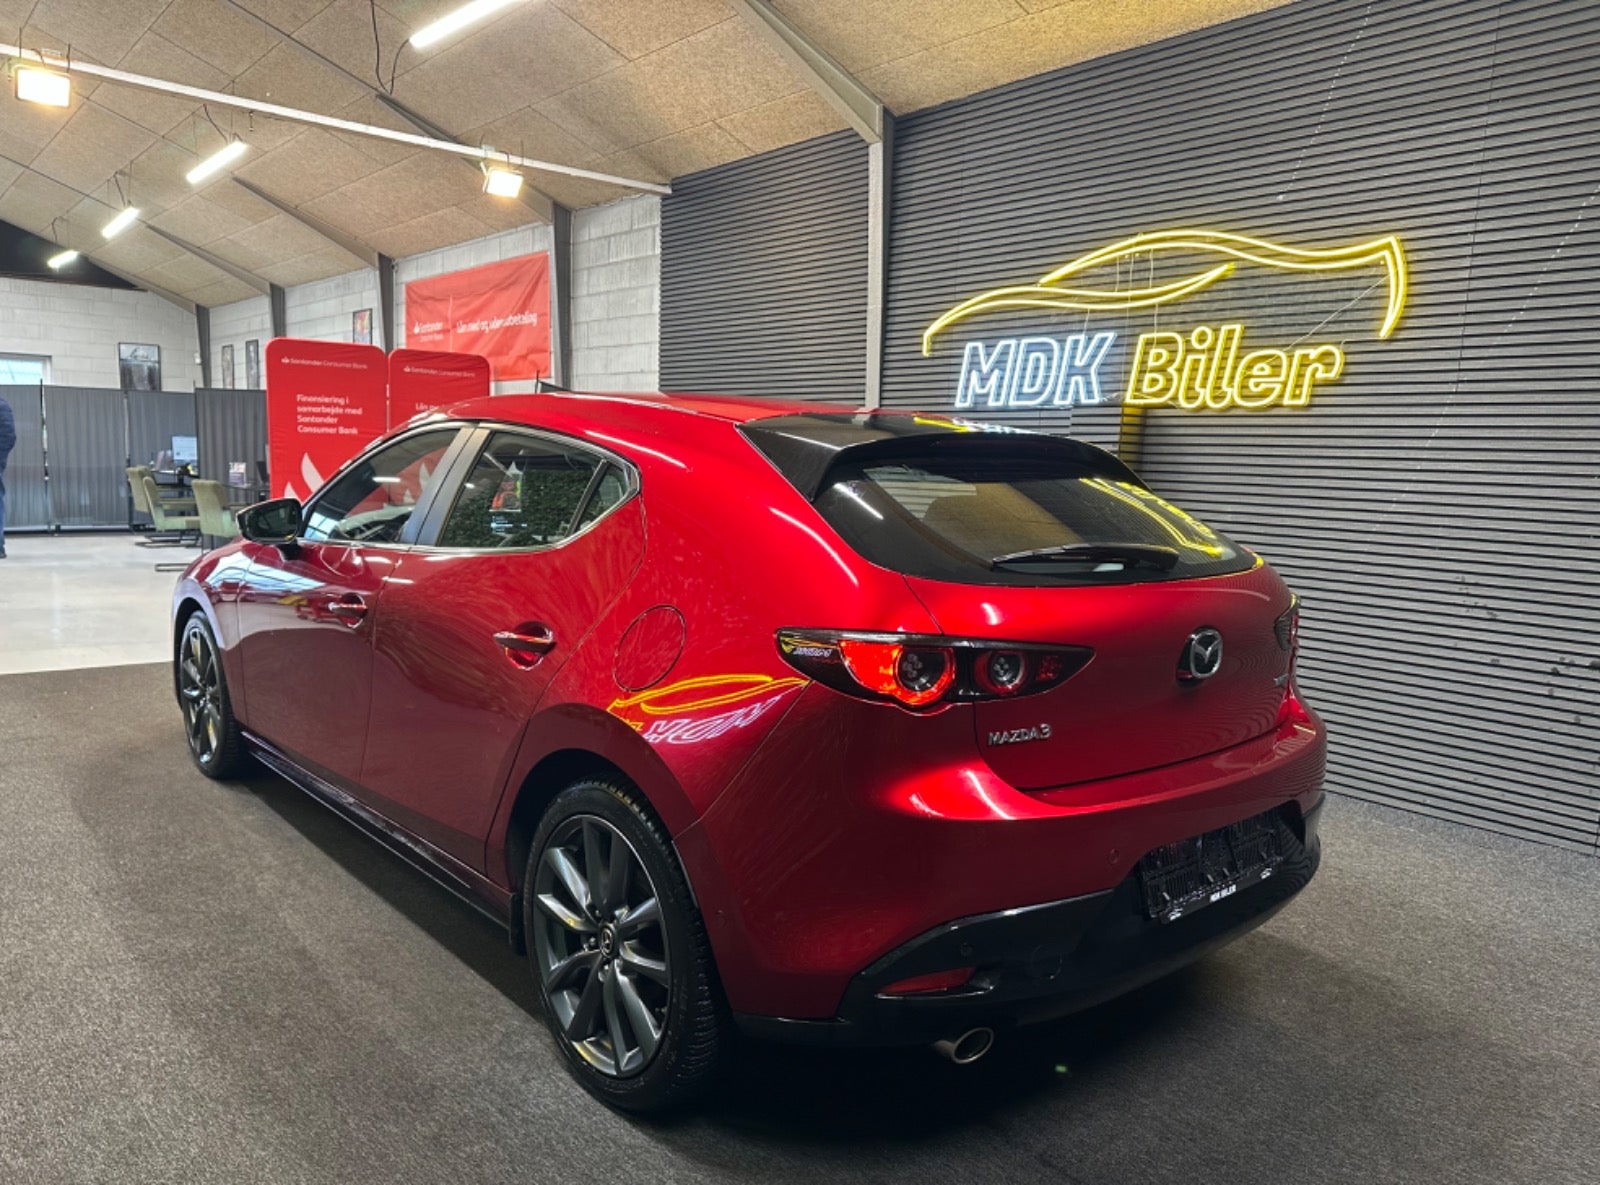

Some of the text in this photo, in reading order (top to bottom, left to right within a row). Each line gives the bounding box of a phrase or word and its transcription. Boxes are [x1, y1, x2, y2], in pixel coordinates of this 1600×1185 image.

[291, 358, 322, 366] Santander
[322, 360, 351, 368] Consumer
[955, 323, 1345, 408] MDK Biler
[297, 394, 345, 405] Finansiering
[297, 405, 363, 415] samarbejde med
[297, 415, 338, 424] Santander
[297, 424, 358, 434] Consumer Bank
